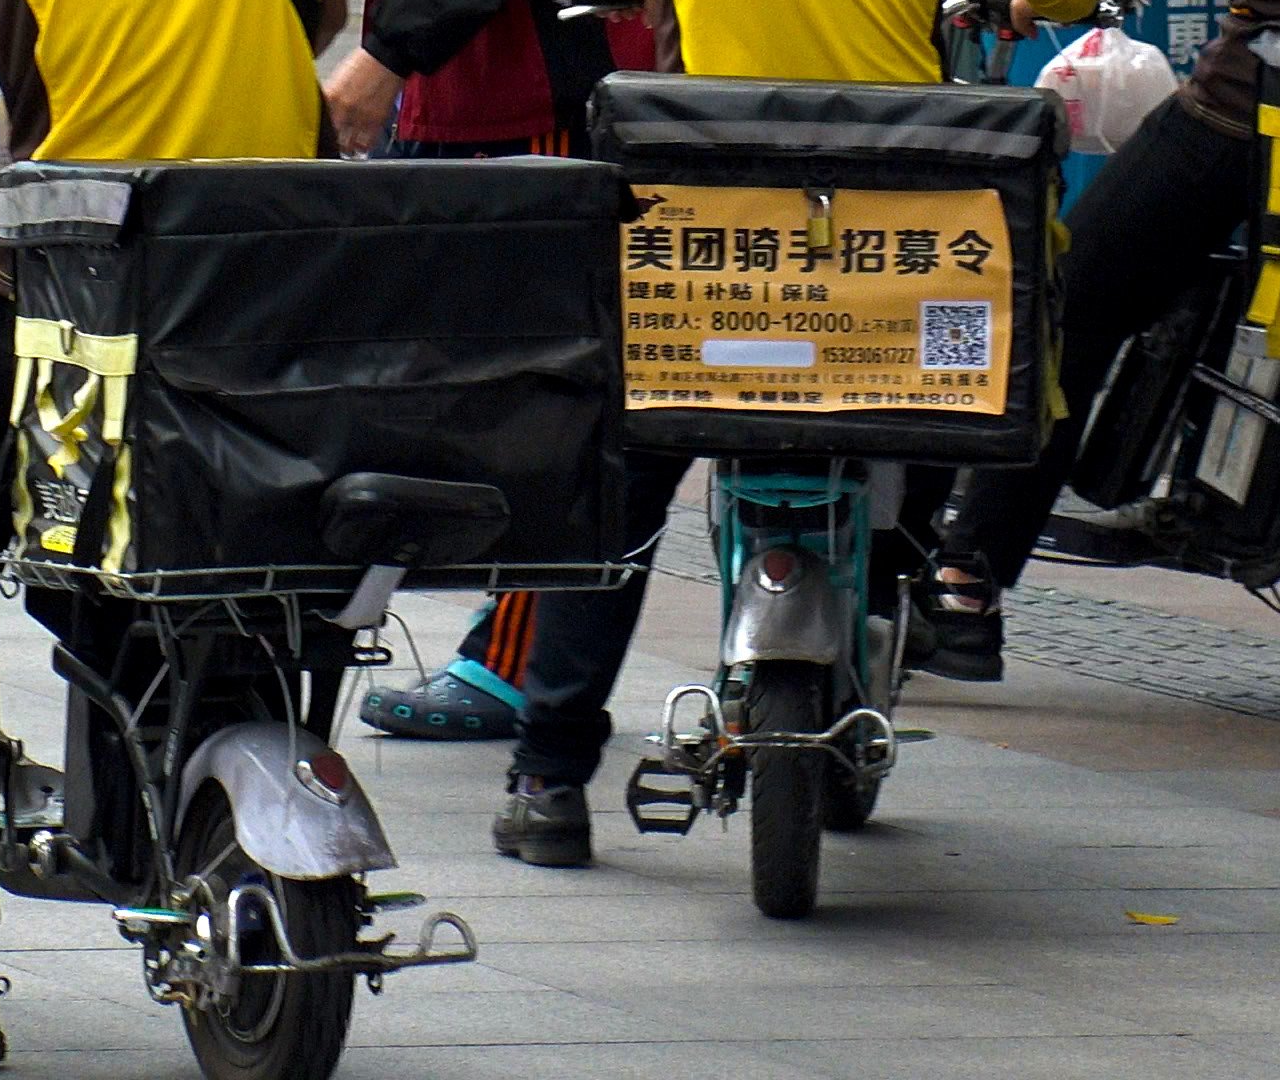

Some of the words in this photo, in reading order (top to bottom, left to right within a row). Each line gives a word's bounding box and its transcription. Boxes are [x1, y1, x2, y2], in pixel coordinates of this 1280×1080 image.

[627, 226, 993, 276] 美团骑手招募令
